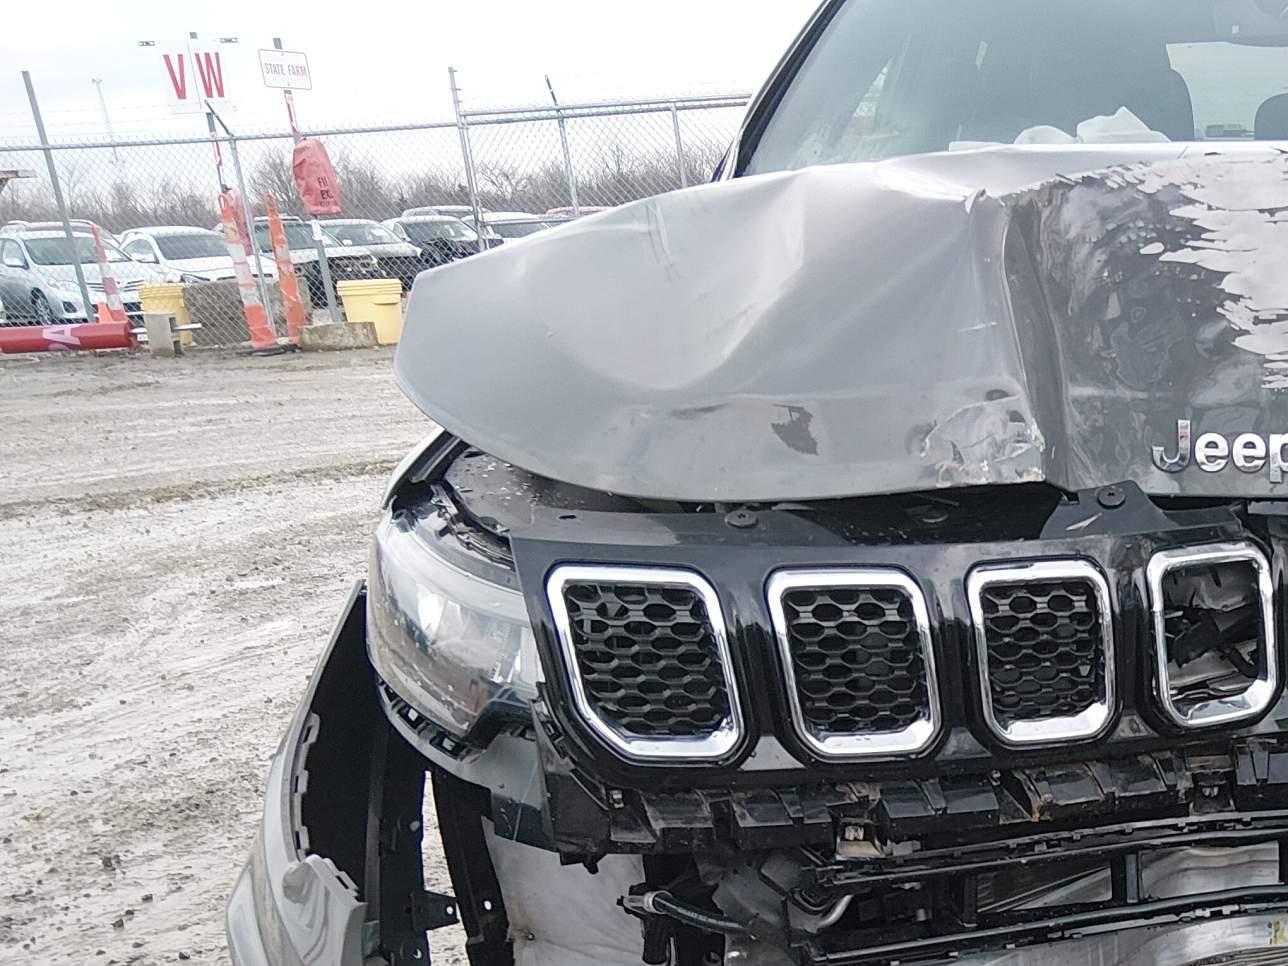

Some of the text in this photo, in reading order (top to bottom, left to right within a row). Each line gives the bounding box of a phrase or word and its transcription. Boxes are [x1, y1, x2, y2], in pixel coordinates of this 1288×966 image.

[162, 52, 225, 99] V W
[264, 62, 308, 78] STATE FARM
